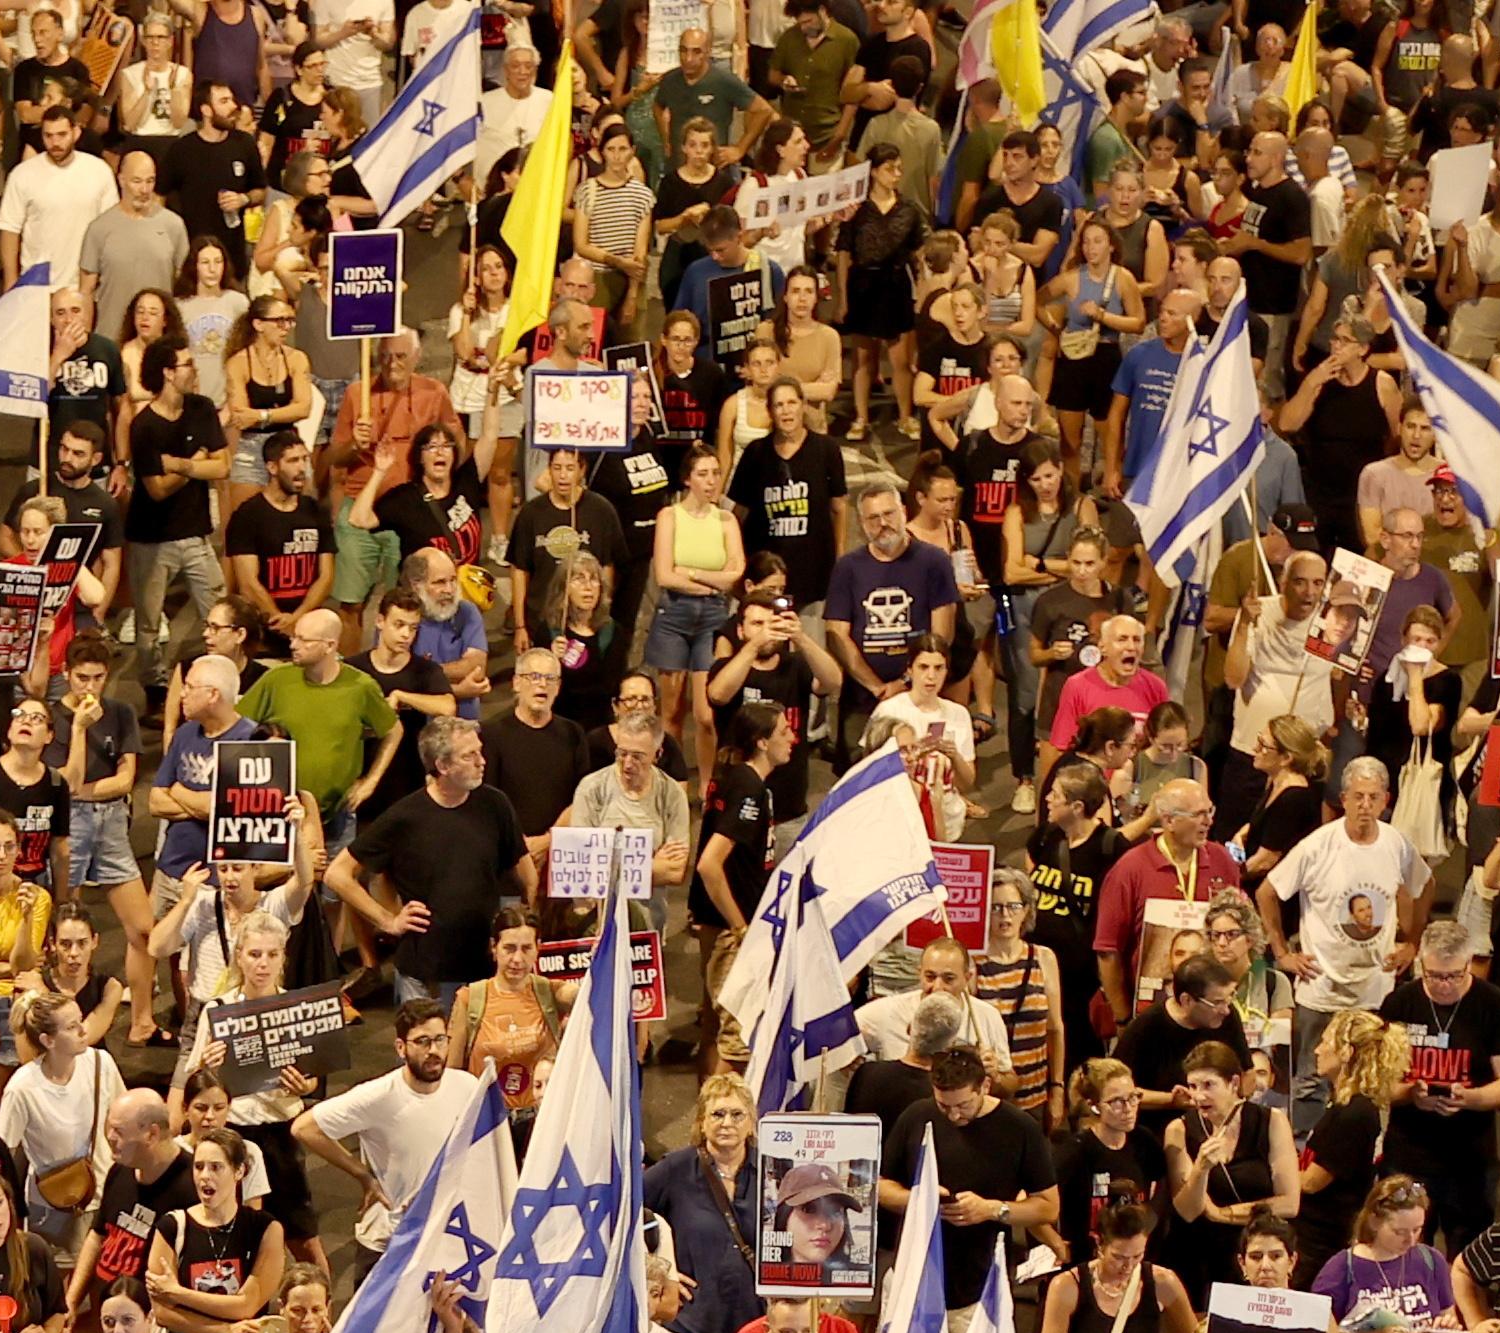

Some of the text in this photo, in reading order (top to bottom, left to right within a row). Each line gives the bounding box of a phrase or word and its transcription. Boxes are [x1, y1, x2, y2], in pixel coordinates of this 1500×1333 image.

[343, 265, 387, 280] אנחנו
[334, 279, 393, 299] התקווה
[238, 758, 272, 785] עם
[225, 787, 282, 816] חטוף
[216, 816, 287, 844] בארצו
[213, 997, 340, 1039] במלחמה כולם
[263, 1014, 343, 1042] מפסידים
[269, 1045, 313, 1062] EVERYONE
[269, 1054, 296, 1068] LOSES
[761, 1230, 793, 1247] BRING
[761, 1246, 782, 1262] HER
